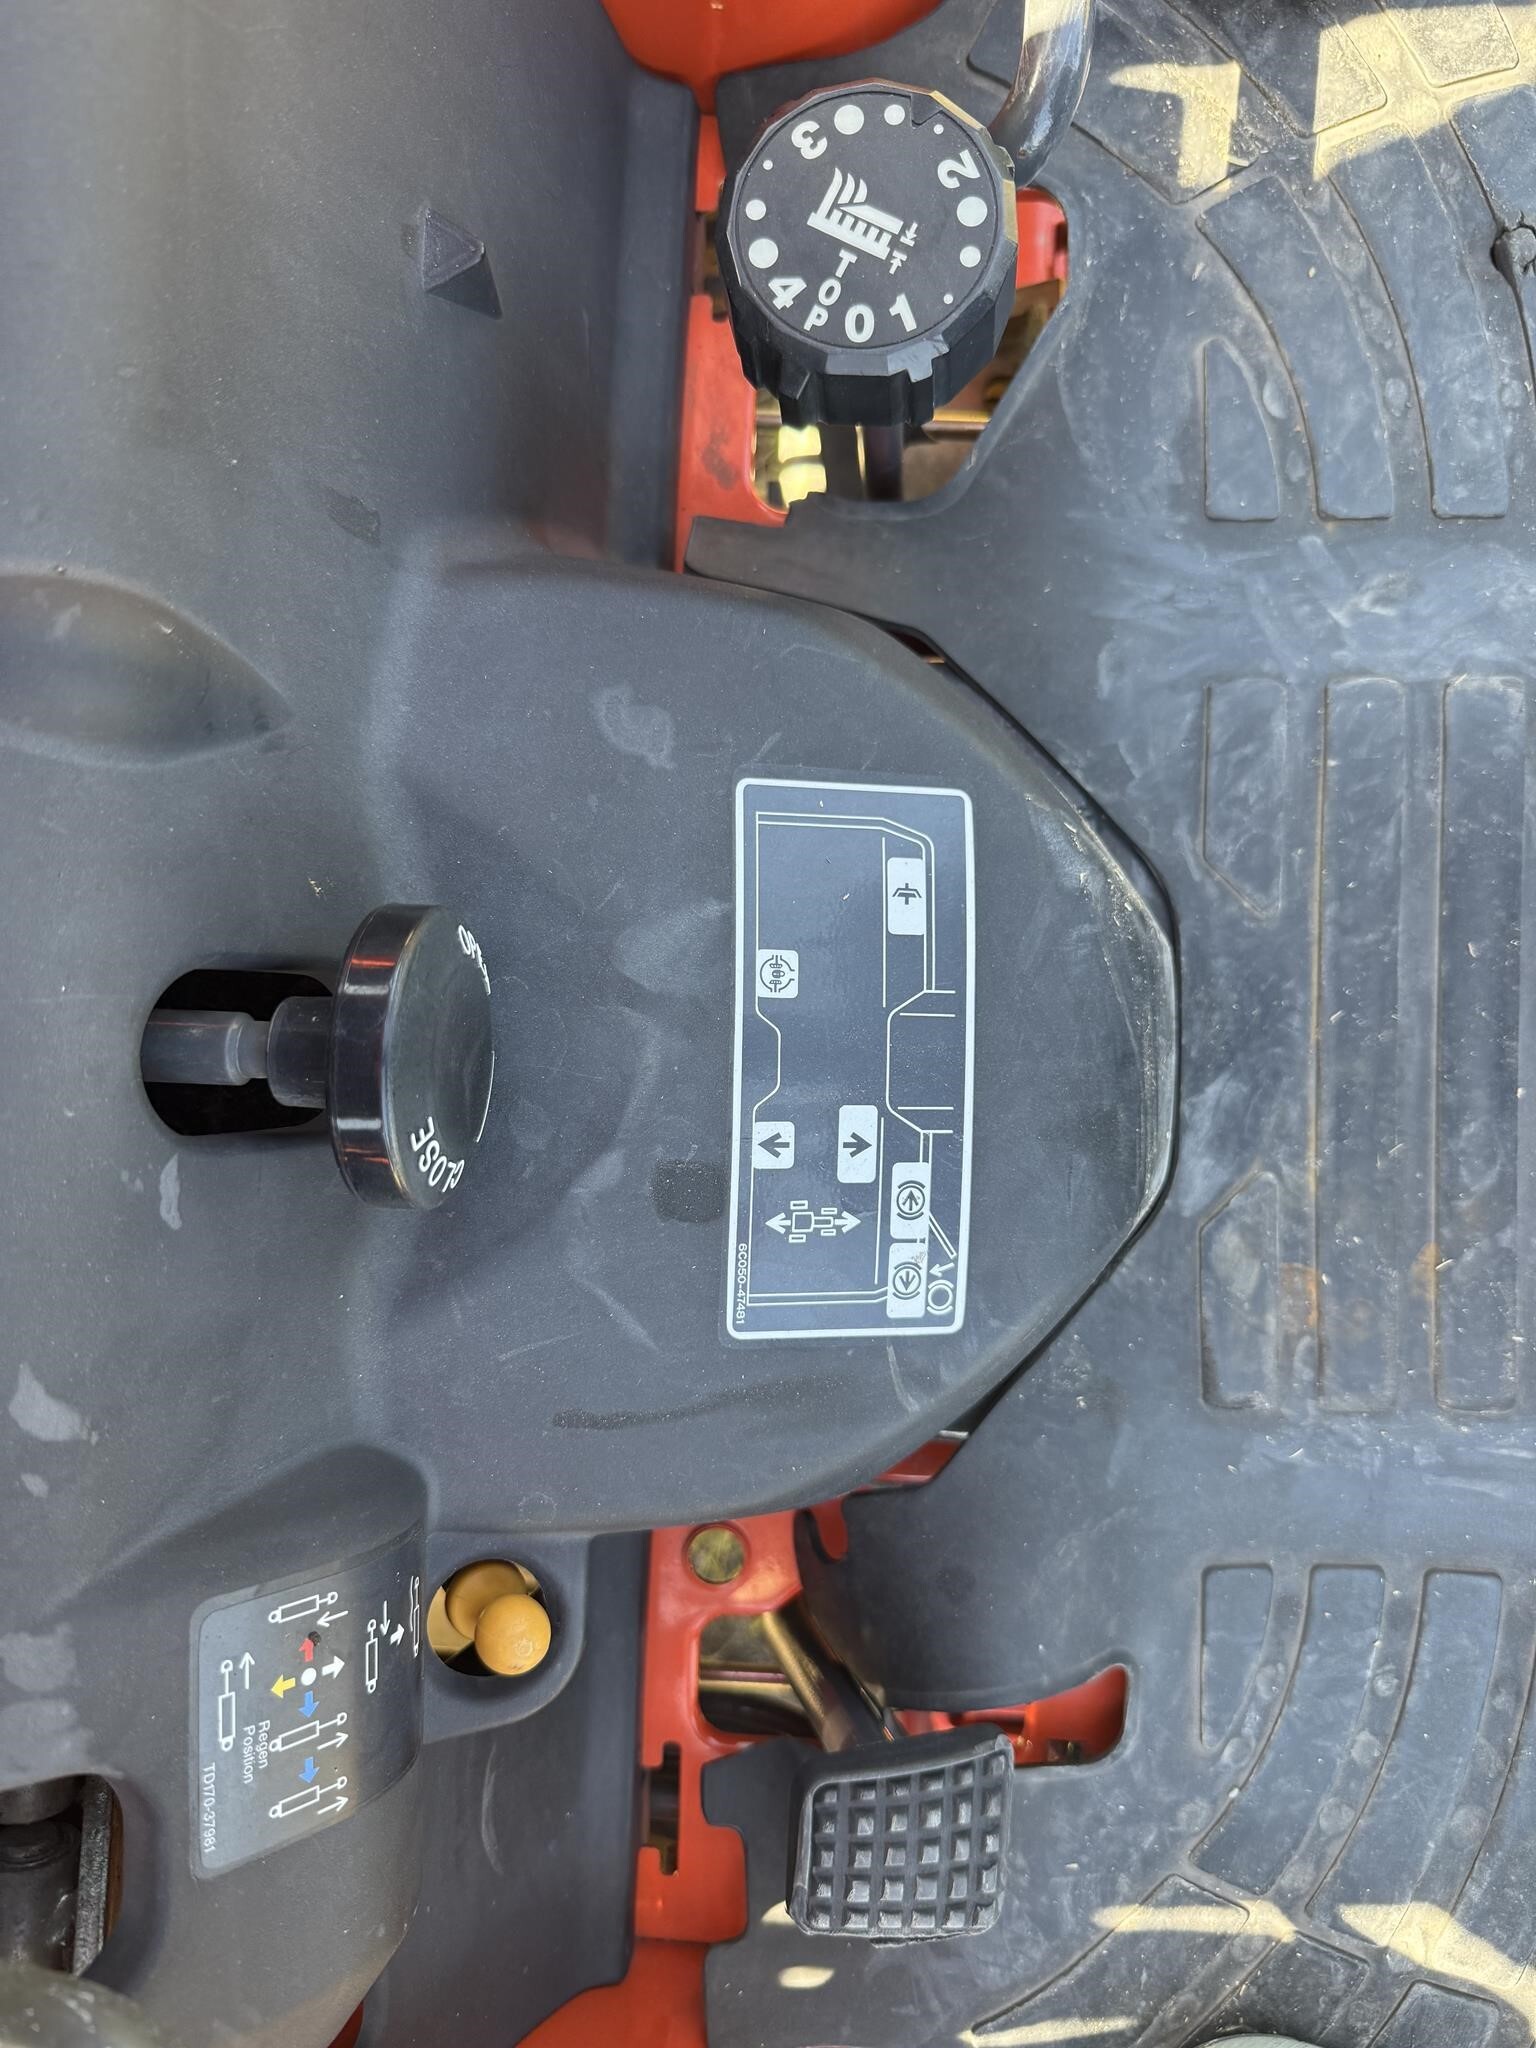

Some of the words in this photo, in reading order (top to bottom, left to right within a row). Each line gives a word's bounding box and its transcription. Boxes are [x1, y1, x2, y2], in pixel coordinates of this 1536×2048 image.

[791, 120, 828, 160] 3
[937, 149, 981, 189] 2
[768, 277, 807, 310] 4
[888, 293, 917, 332] 1
[844, 303, 875, 343] 0
[410, 1115, 465, 1193] CLOSE
[735, 1243, 747, 1324] 6C050-47481
[243, 1725, 255, 1784] Position
[257, 1720, 270, 1769] Regen
[202, 1762, 216, 1852] TD170-37981
